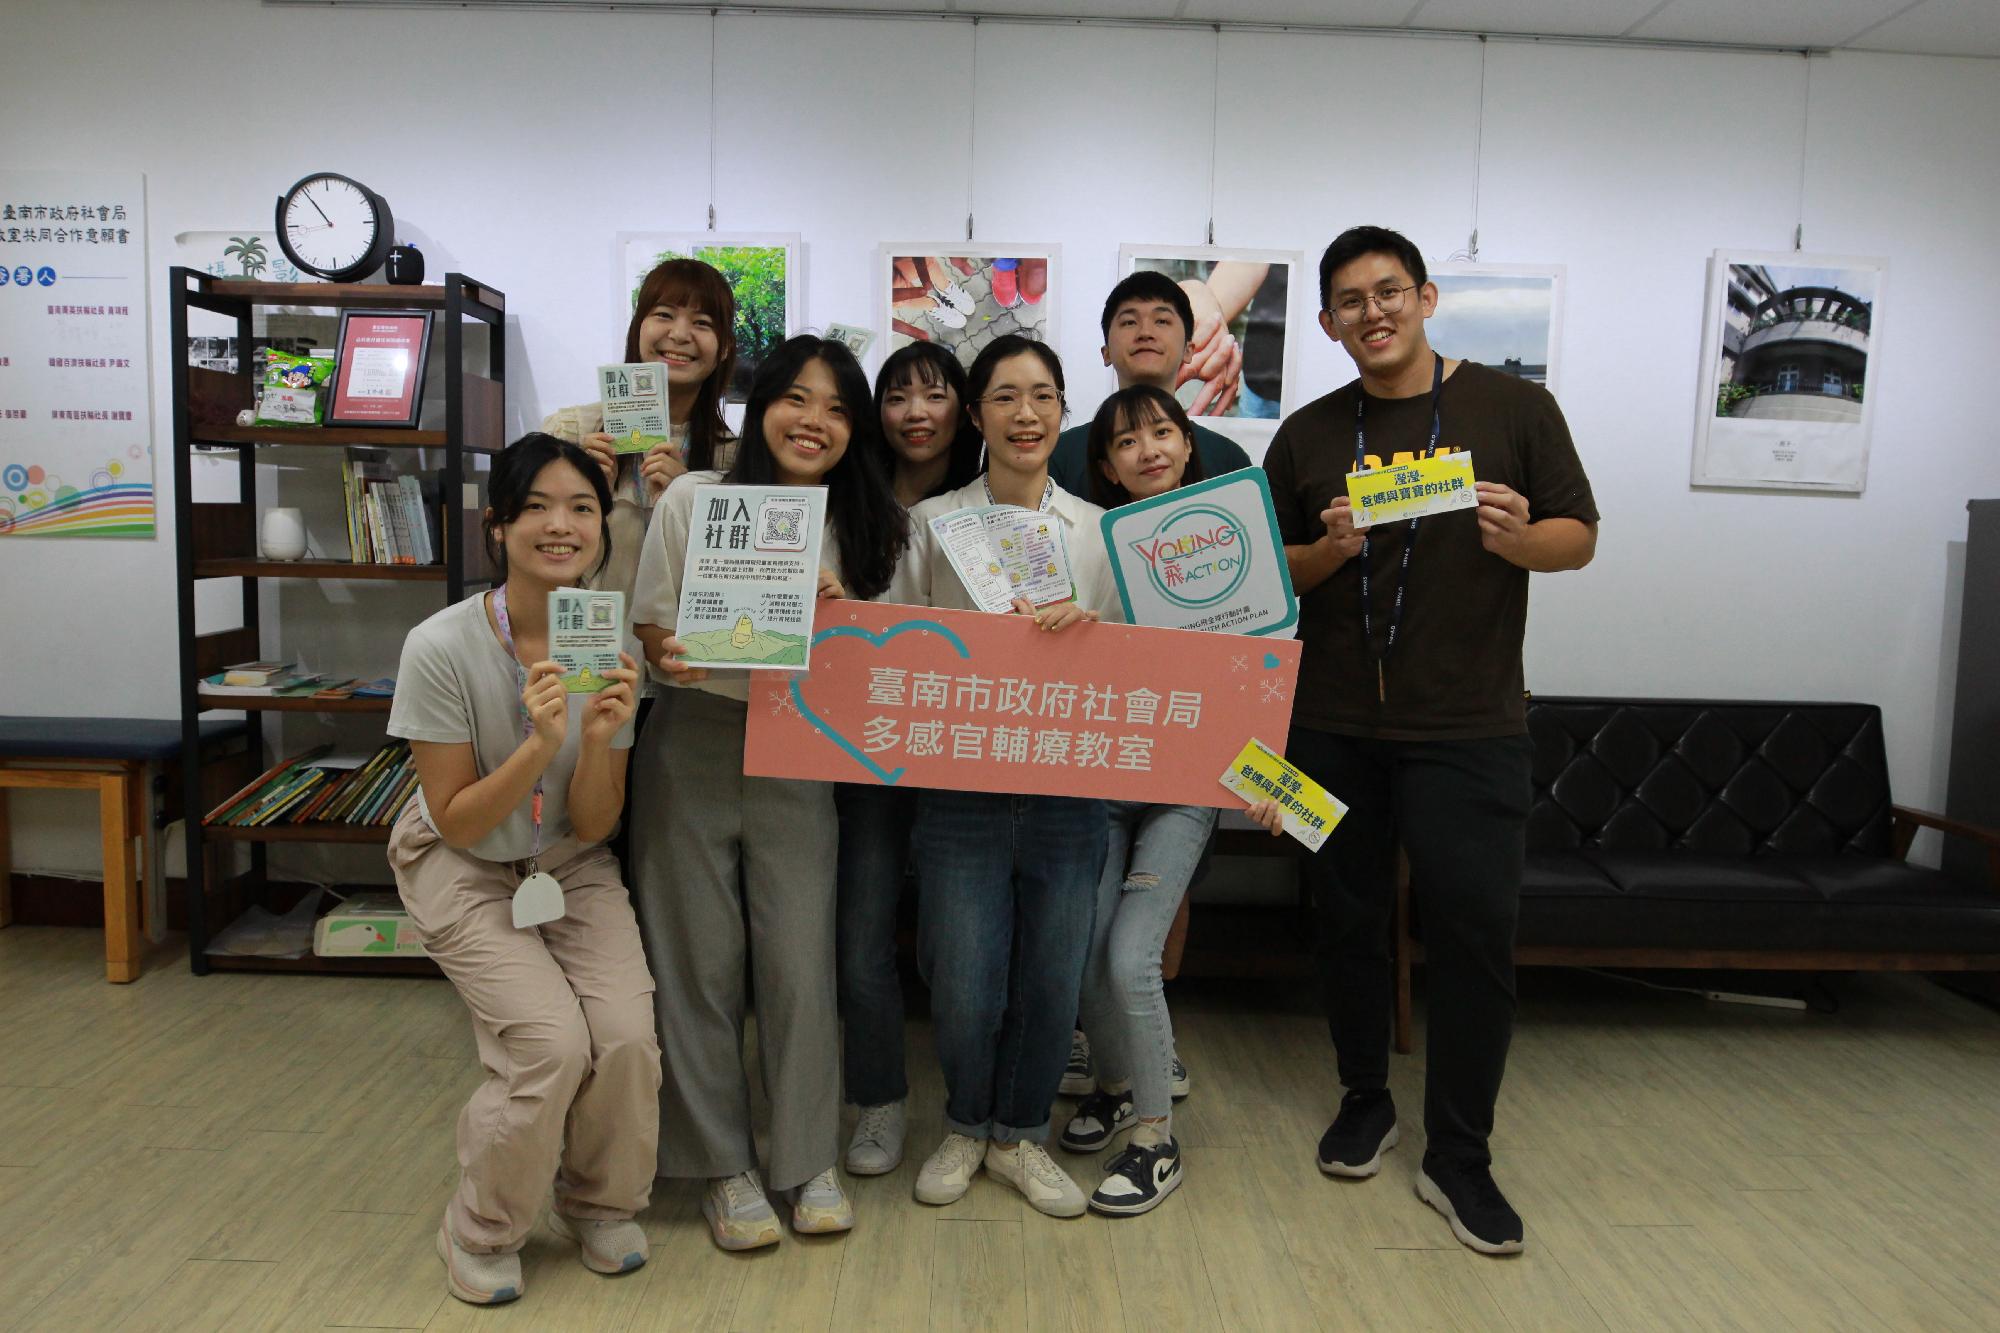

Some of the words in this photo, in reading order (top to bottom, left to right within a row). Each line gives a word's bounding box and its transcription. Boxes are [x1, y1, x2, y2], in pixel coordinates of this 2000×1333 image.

[3, 204, 126, 221] 臺南市政府社會局
[606, 371, 628, 384] 加入
[607, 384, 629, 398] 社群
[1360, 476, 1465, 508] 爸媽與寶寶的社群
[706, 497, 751, 522] 加入
[704, 523, 751, 550] 社群
[1184, 555, 1241, 583] ACTION
[1221, 616, 1249, 629] ACTION
[1249, 609, 1269, 620] PLAN
[866, 666, 1203, 730] 臺南市政府社會局
[863, 714, 1155, 772] 多感官輔療教室
[1240, 764, 1327, 830] 爸媽與寶寶的社群
